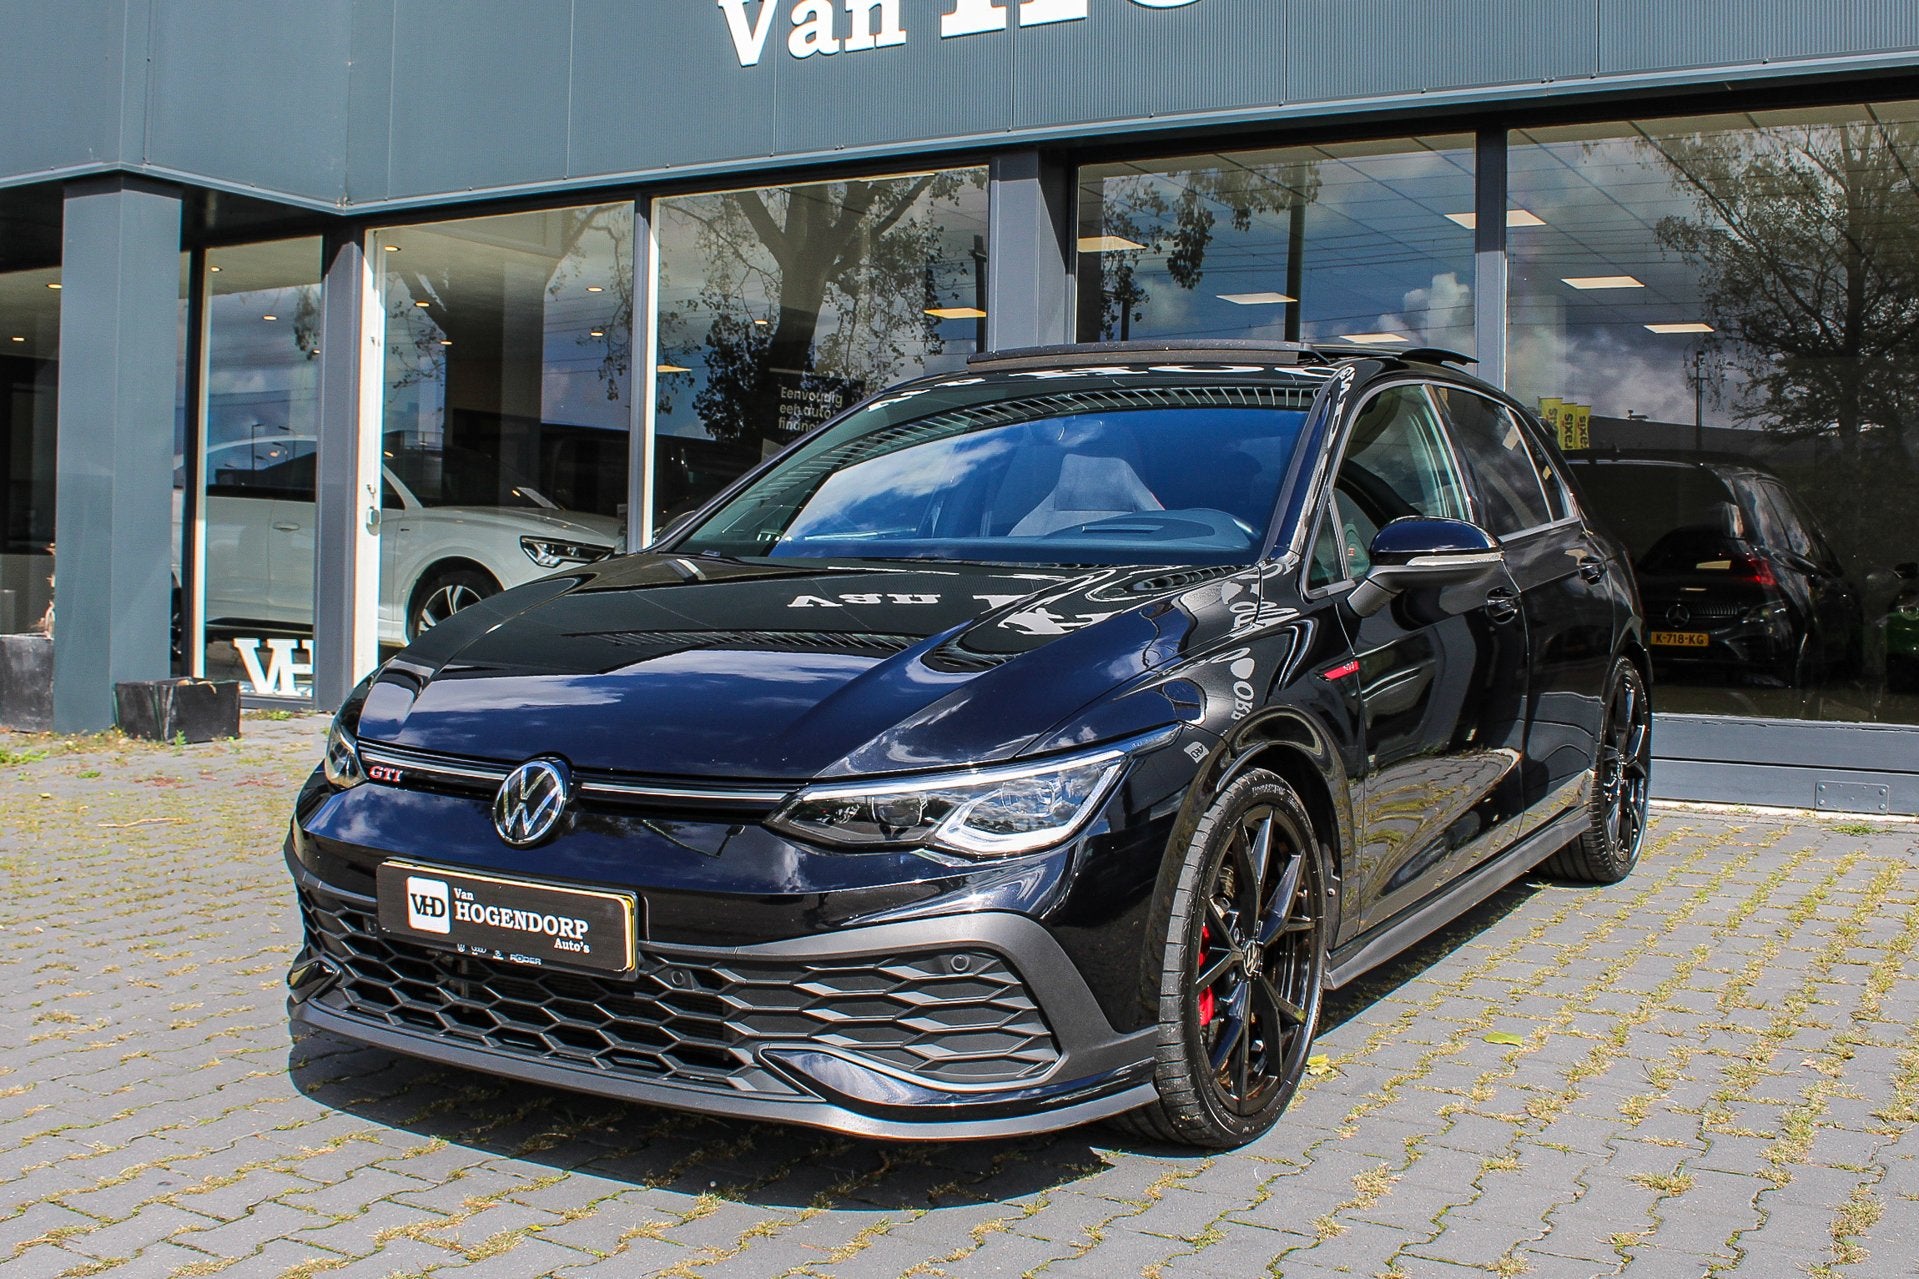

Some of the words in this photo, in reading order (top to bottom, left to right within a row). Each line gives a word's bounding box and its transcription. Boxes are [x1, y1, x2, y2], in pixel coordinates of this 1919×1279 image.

[718, 0, 906, 67] Van
[780, 386, 843, 408] Eenvoudig
[1655, 633, 1705, 645] K-718-KG
[369, 765, 403, 783] GTI
[453, 887, 475, 901] Van
[410, 892, 446, 918] VHD
[454, 900, 589, 940] HOGENDORP
[553, 937, 591, 954] Auto's
